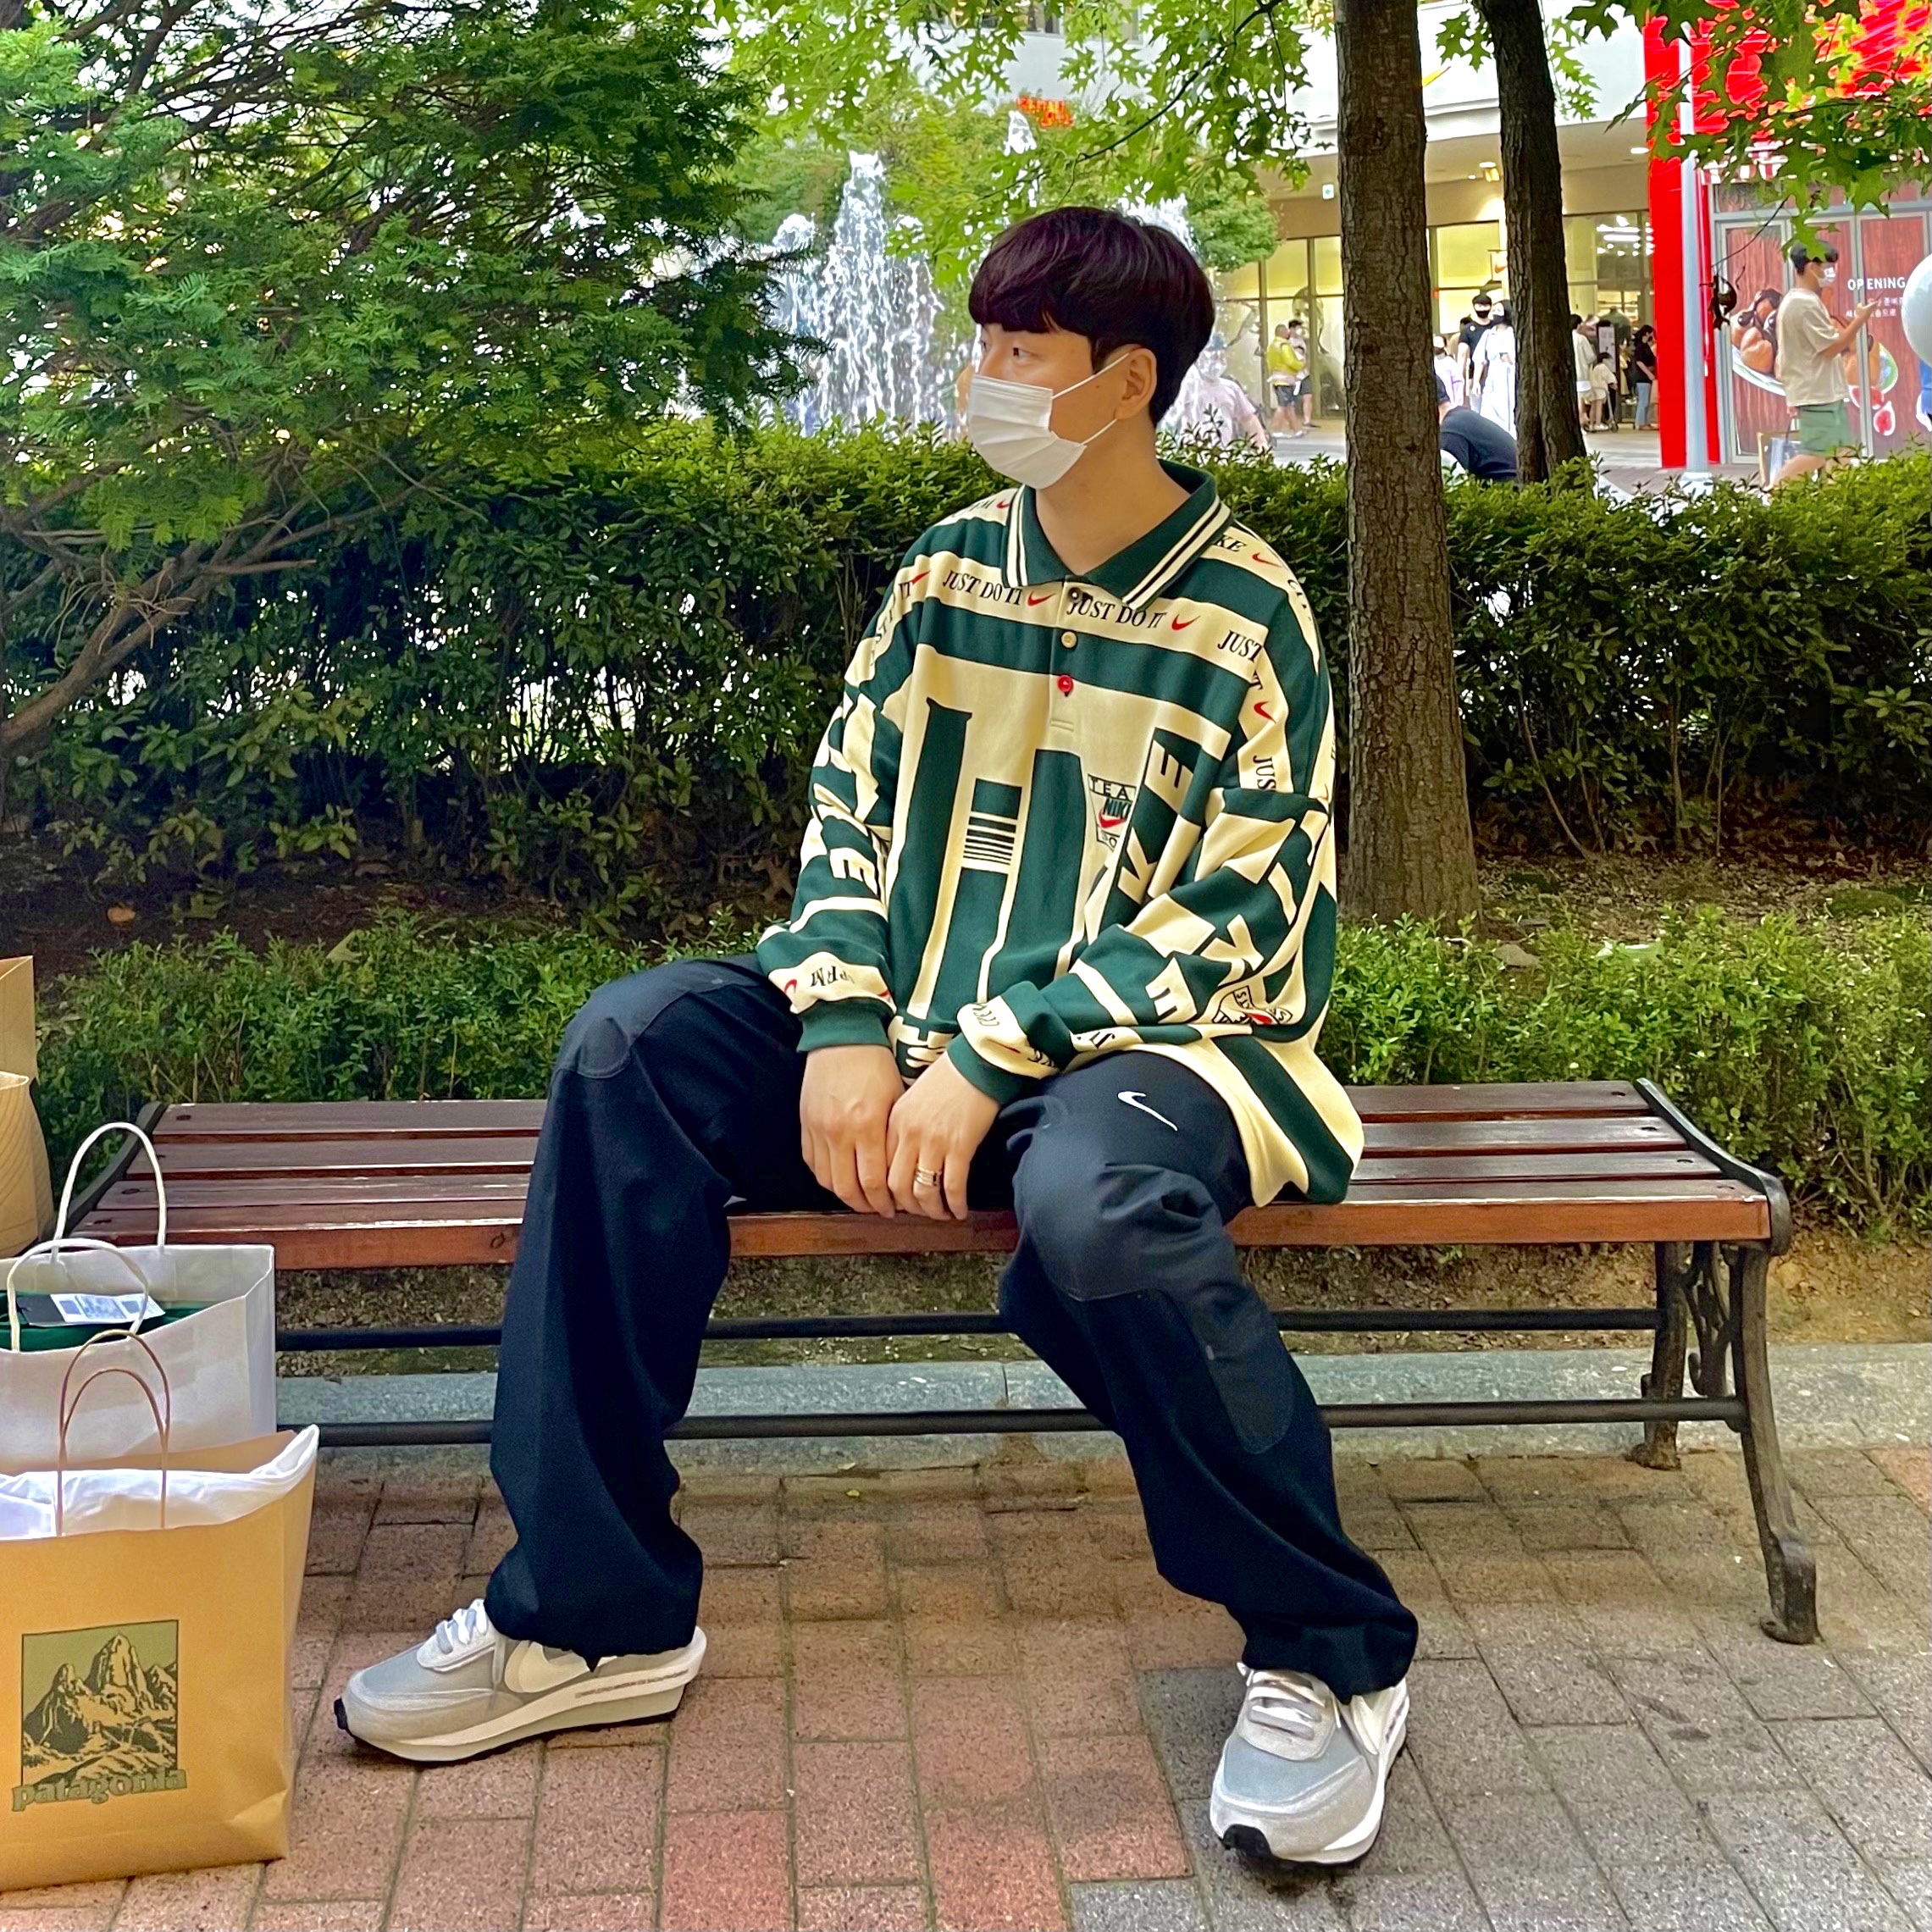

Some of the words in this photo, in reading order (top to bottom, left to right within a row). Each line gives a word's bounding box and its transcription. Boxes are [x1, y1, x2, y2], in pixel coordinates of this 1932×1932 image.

[1847, 277, 1906, 290] OPENING
[942, 569, 982, 595] JUST
[980, 581, 1003, 601] DO
[1005, 586, 1023, 606] IT
[1066, 594, 1116, 621] JUST
[1117, 606, 1148, 628] DO
[1147, 611, 1167, 629] IT
[1217, 630, 1263, 663] JUST
[12, 1769, 187, 1812] patagonia
